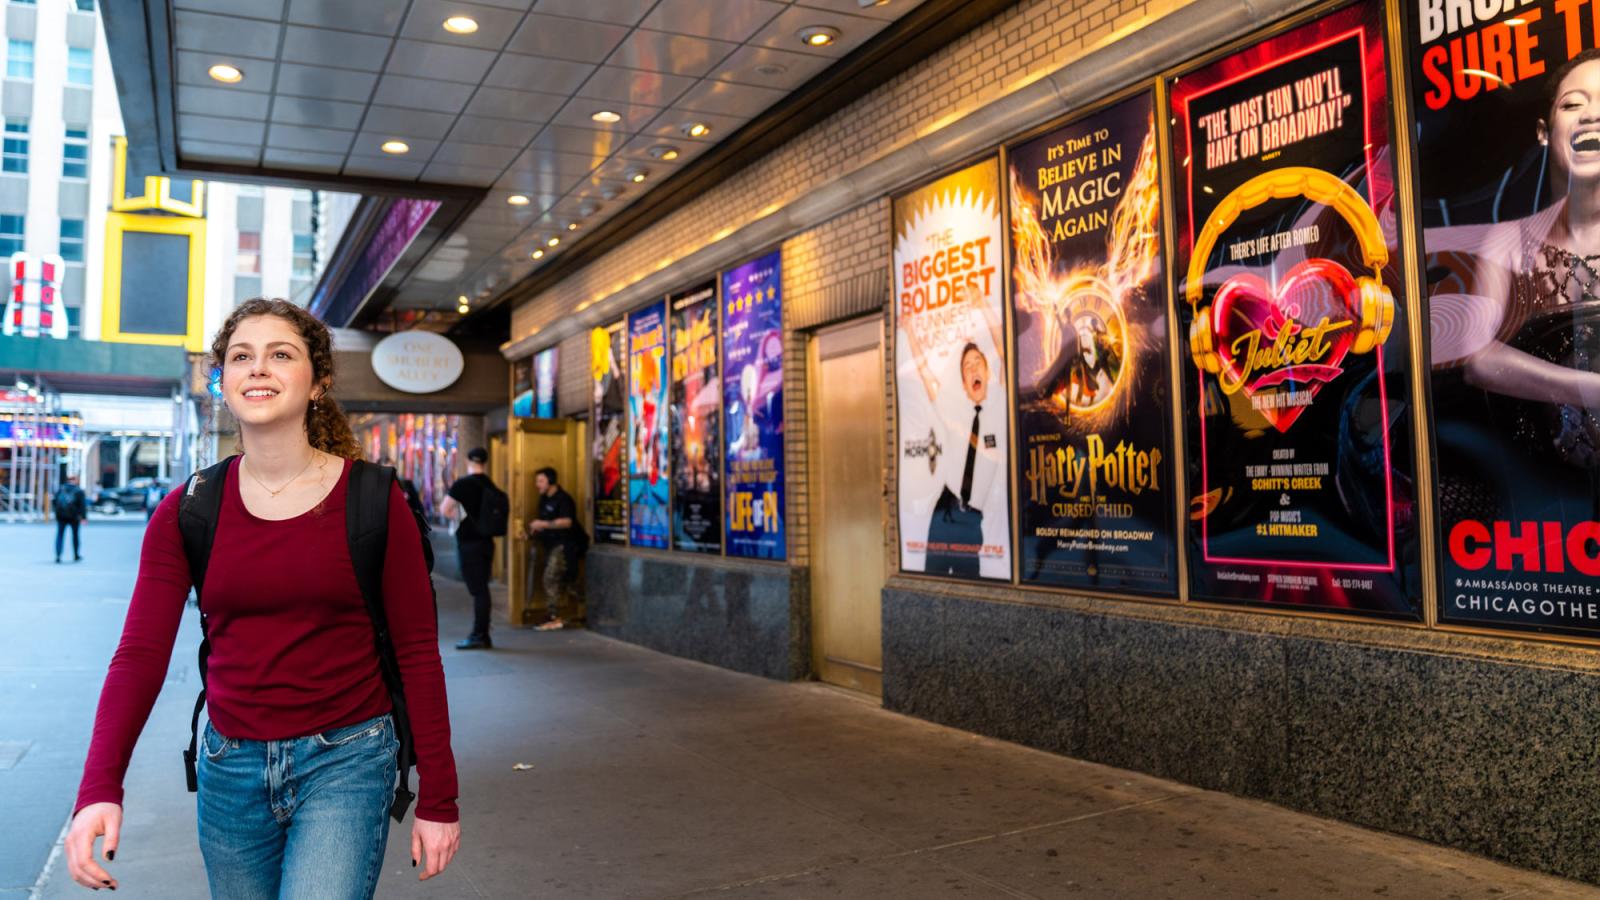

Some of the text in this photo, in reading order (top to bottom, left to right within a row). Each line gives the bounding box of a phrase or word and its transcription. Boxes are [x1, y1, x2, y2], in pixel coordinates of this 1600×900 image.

[1422, 7, 1546, 111] SURE
[1198, 67, 1343, 142] "THE MOST FUN YOU'LL
[1047, 128, 1109, 161] IT'S TIME TO
[1206, 94, 1352, 169] HAVE ON BROADWAY!"
[1038, 143, 1122, 191] BELIEVE IN
[1041, 171, 1120, 221] MAGIC
[1053, 209, 1108, 243] AGAIN
[1230, 224, 1320, 261] THERE'S LIFE AFTER ROMEO
[903, 236, 991, 289] BIGGEST
[901, 267, 995, 317] BOLDEST
[403, 341, 432, 352] ONE
[1219, 316, 1353, 395] Juliet
[1261, 393, 1275, 409] NEW
[1276, 391, 1285, 408] HIT
[1286, 389, 1313, 408] MUSICAL
[1025, 433, 1162, 505] Harry Potter
[1251, 477, 1322, 490] SCHITT'S CREEK
[730, 491, 754, 532] LIFE
[752, 498, 764, 527] OF
[763, 490, 778, 533] PI
[1052, 502, 1133, 519] CURSED CHILD
[1279, 493, 1291, 506] &
[1036, 527, 1154, 541] BOLDLY REIMAGINED ON BROADWAY
[1256, 523, 1318, 537] #1 HITMAKER
[1448, 519, 1600, 577] CHIC
[1465, 578, 1538, 592] AMBASSADOR
[1543, 583, 1592, 595] THEATRE
[1455, 594, 1598, 619] CHICAGOTHE
